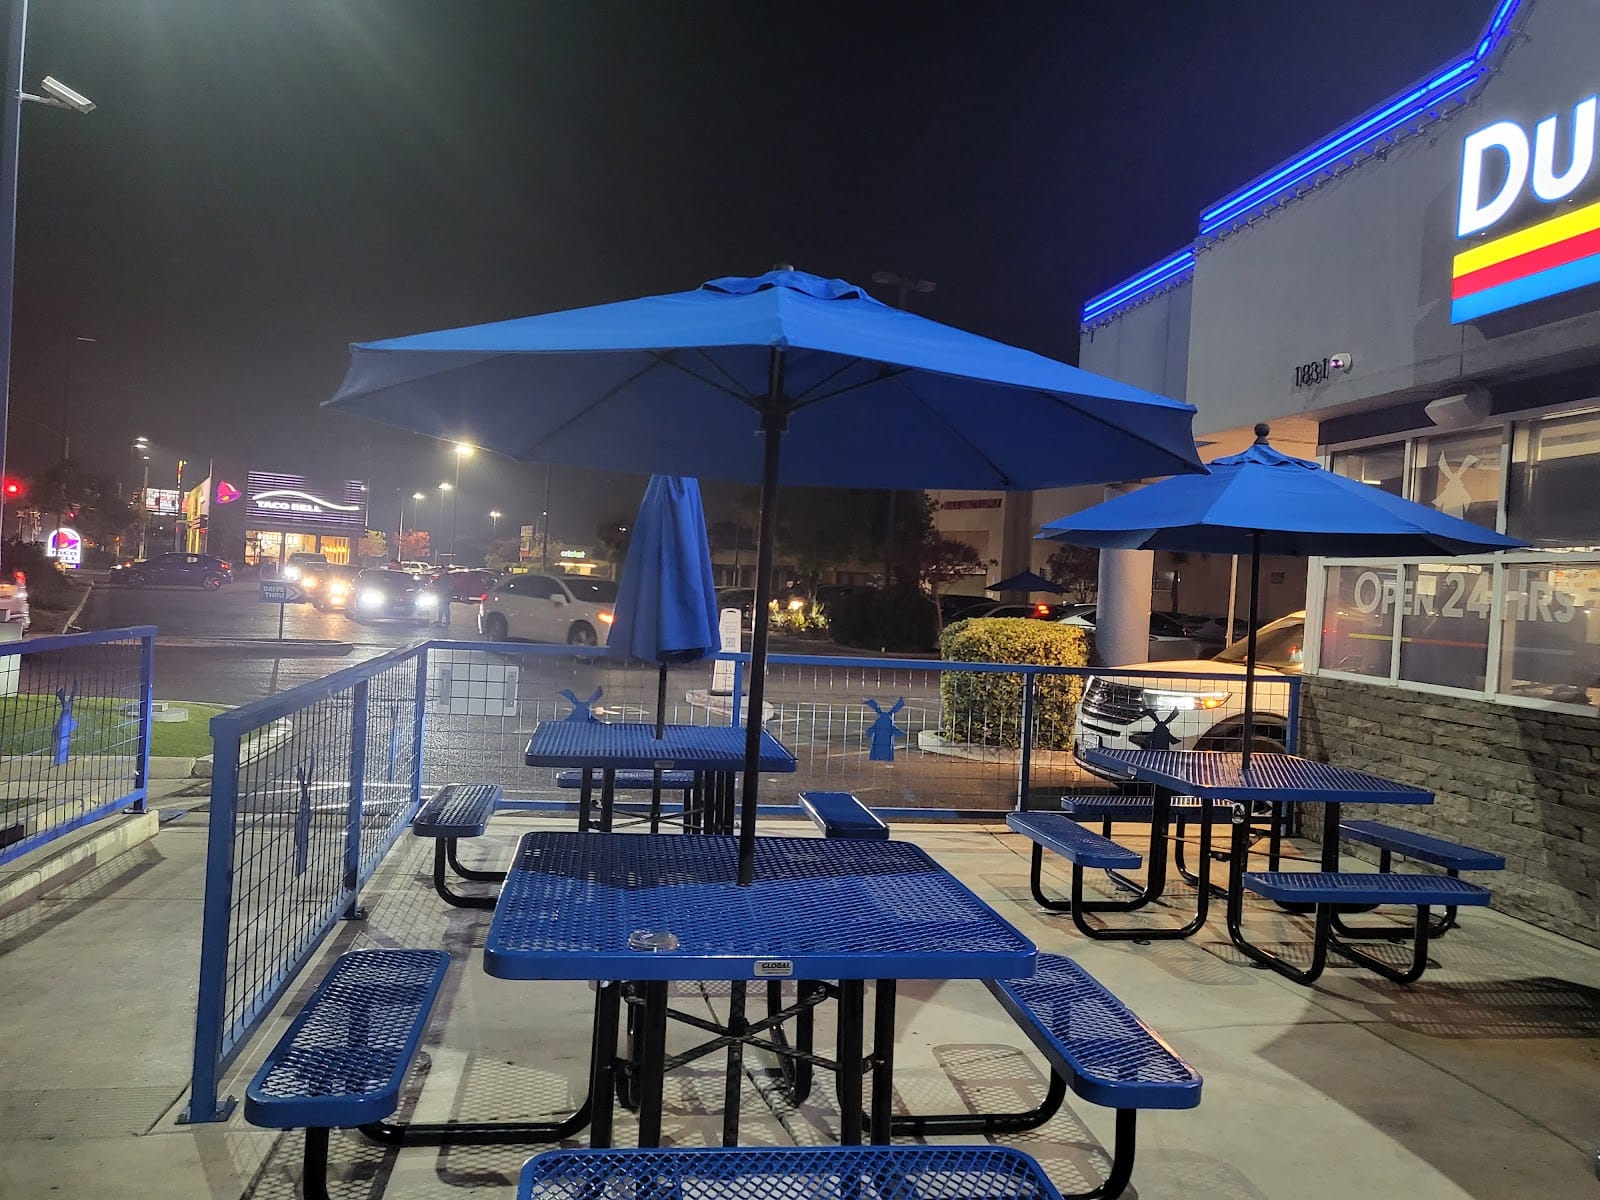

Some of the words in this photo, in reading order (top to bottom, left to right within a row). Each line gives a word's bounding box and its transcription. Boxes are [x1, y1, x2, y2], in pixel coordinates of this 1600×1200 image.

[256, 501, 290, 510] TACO
[291, 503, 323, 512] BELL
[263, 585, 285, 593] DRIVE
[264, 591, 285, 599] THRU
[1441, 571, 1492, 620] 24
[1501, 569, 1577, 623] HRS
